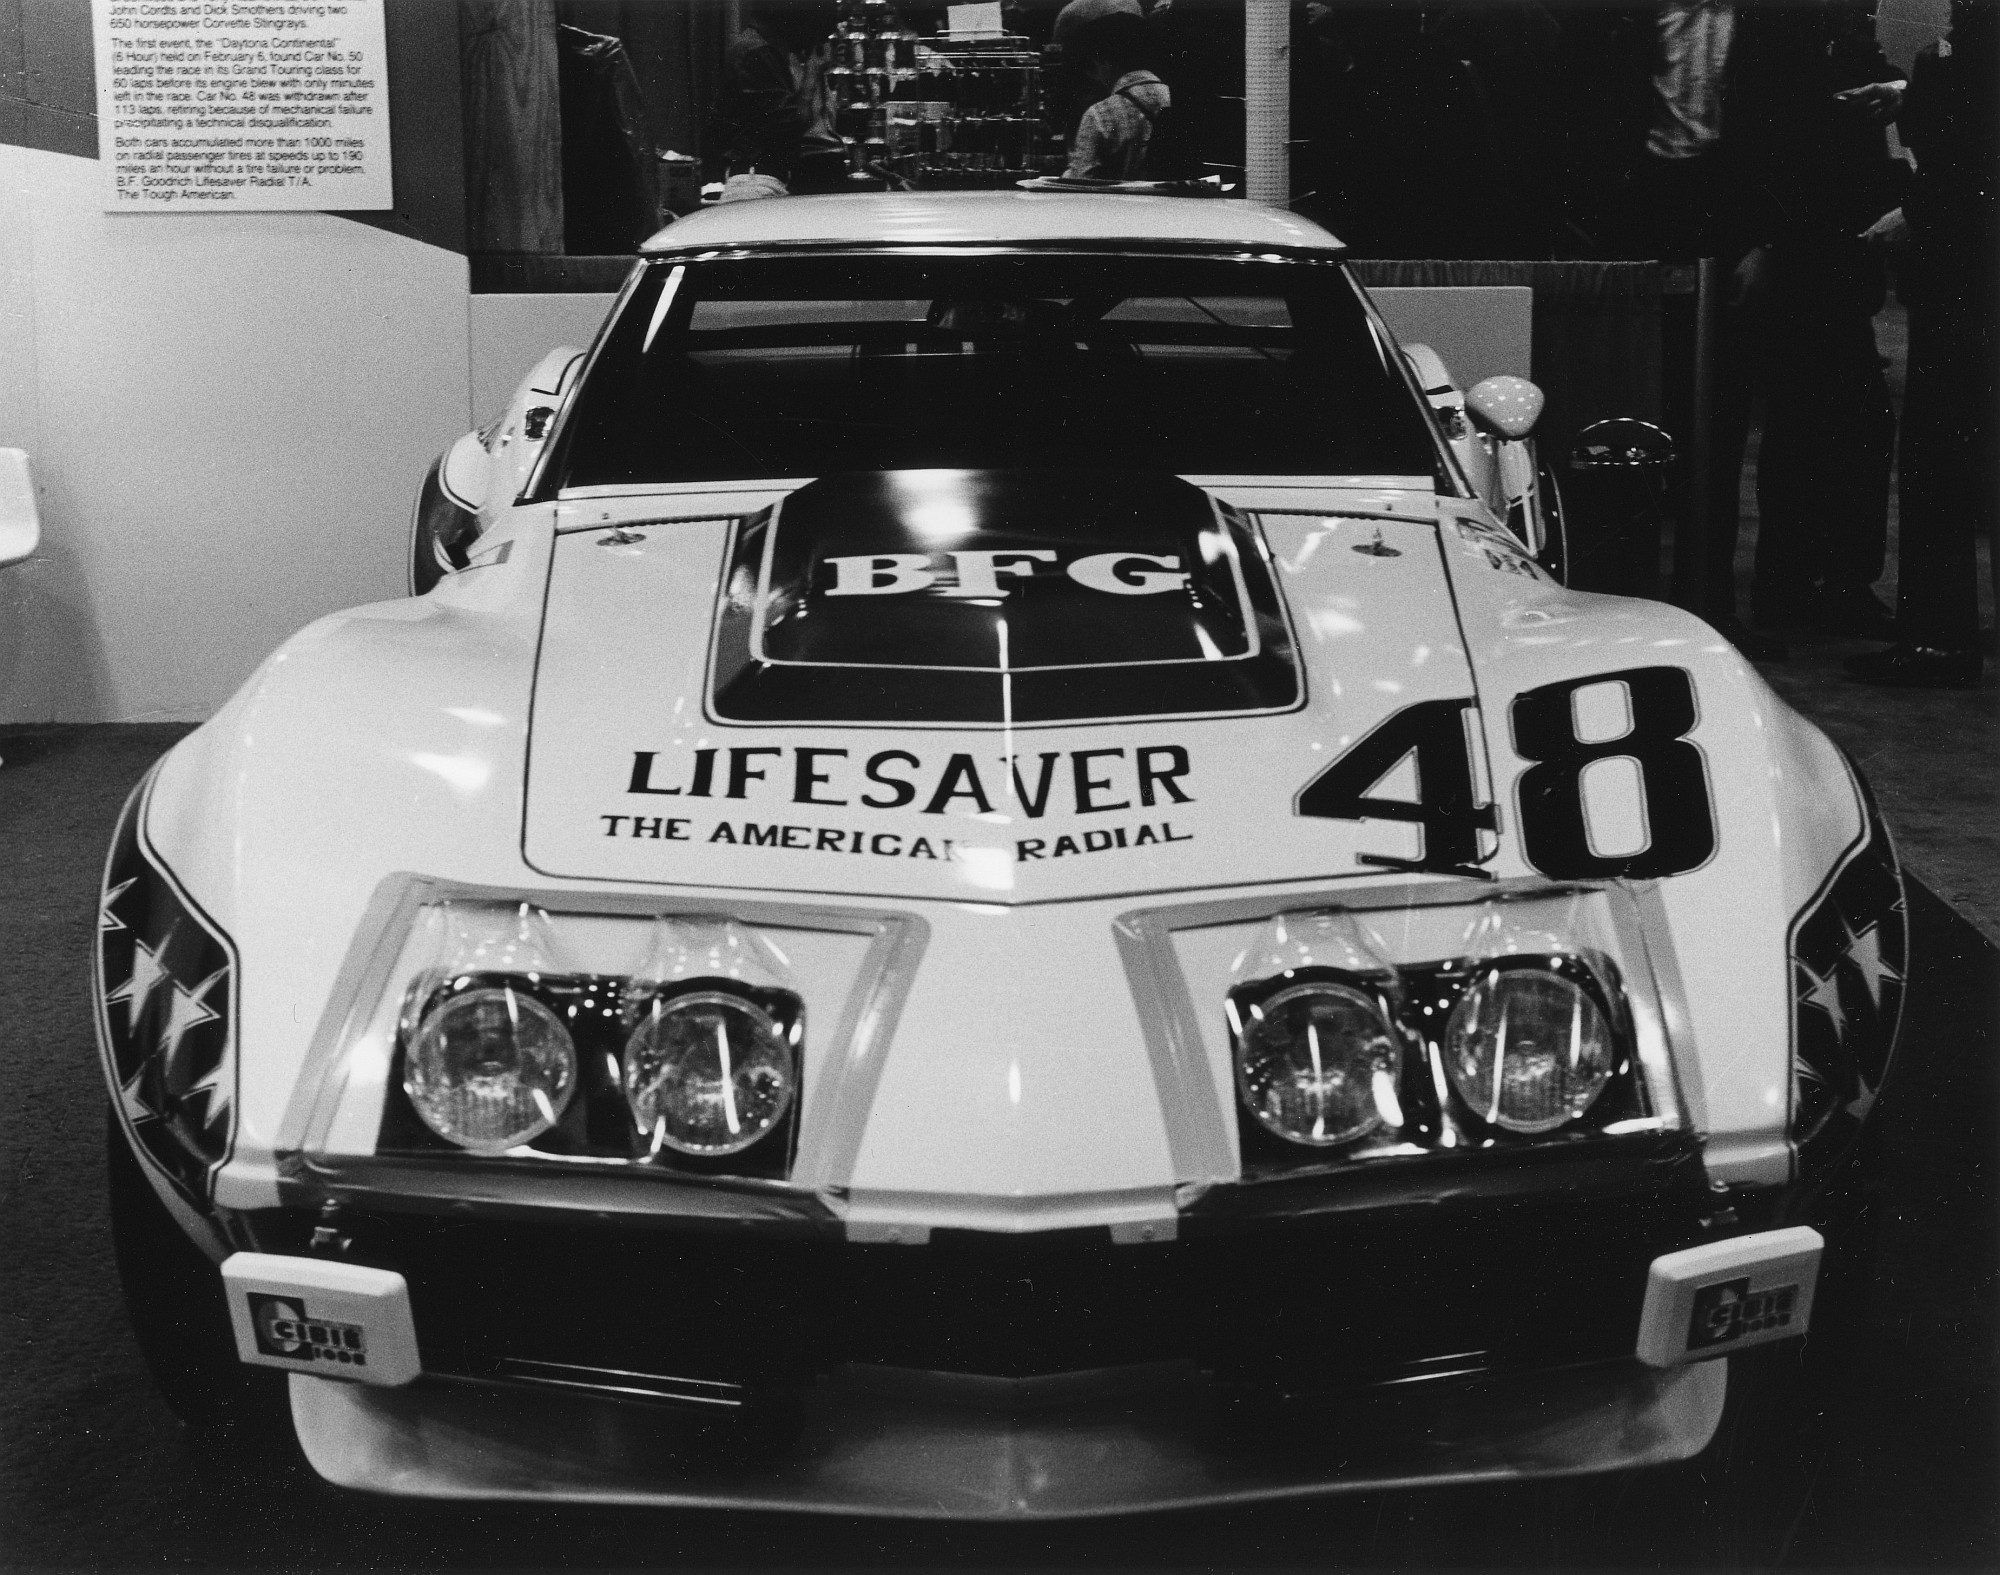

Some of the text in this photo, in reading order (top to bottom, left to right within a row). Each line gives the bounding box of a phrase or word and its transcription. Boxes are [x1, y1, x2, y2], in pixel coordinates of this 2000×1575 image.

[109, 5, 137, 15] John
[181, 5, 201, 15] and
[204, 5, 227, 15] Dick
[231, 5, 285, 15] Smothers
[288, 5, 326, 17] driving
[328, 5, 348, 15] two
[110, 18, 132, 29] 650
[134, 18, 200, 31] horsepower
[203, 18, 251, 29] Corvette
[111, 38, 133, 48] The
[136, 38, 156, 48] first
[195, 38, 213, 48] the
[127, 51, 158, 64] Hour)
[160, 51, 184, 62] held
[187, 52, 200, 62] on
[204, 51, 254, 64] February
[270, 51, 302, 62] found
[304, 51, 324, 62] Car
[348, 51, 364, 62] 50
[113, 65, 362, 77] leading the race in its Grand Touring class for
[131, 78, 153, 90] laps
[156, 78, 192, 88] before
[195, 78, 208, 88] its
[210, 78, 248, 90] engine
[251, 78, 277, 88] blew
[279, 78, 302, 88] with
[304, 78, 327, 90] only
[330, 78, 375, 88] minutes
[114, 91, 131, 101] left
[134, 91, 144, 101] in
[146, 91, 164, 101] the
[196, 91, 217, 101] Car
[242, 91, 256, 101] 48
[258, 92, 281, 101] was
[284, 91, 340, 101] withdrawn
[343, 91, 369, 101] after
[115, 105, 136, 114] 113
[166, 105, 207, 117] retiring
[208, 105, 256, 114] because
[259, 105, 270, 114] of
[272, 105, 336, 114] mechanical
[338, 105, 373, 114] failure
[195, 118, 245, 128] technical
[115, 137, 364, 147] Both cars accumulated more than 1000 miles
[115, 151, 363, 163] on radial passenger tires at speeds up to 190
[116, 163, 146, 173] miles
[149, 165, 162, 173] an
[166, 163, 191, 173] hour
[193, 163, 234, 173] without
[246, 163, 264, 173] tire
[266, 163, 301, 173] failure
[303, 165, 315, 173] or
[141, 176, 193, 186] Goodrich
[195, 176, 246, 186] Lifesaver
[249, 176, 285, 186] Radial
[117, 189, 139, 199] The
[142, 189, 178, 202] Tough
[823, 550, 1191, 598] BFG
[1293, 665, 1720, 881] 48
[626, 744, 1196, 819] LIFESAVER
[601, 815, 692, 841] THE
[1015, 822, 1194, 862] RADIAL
